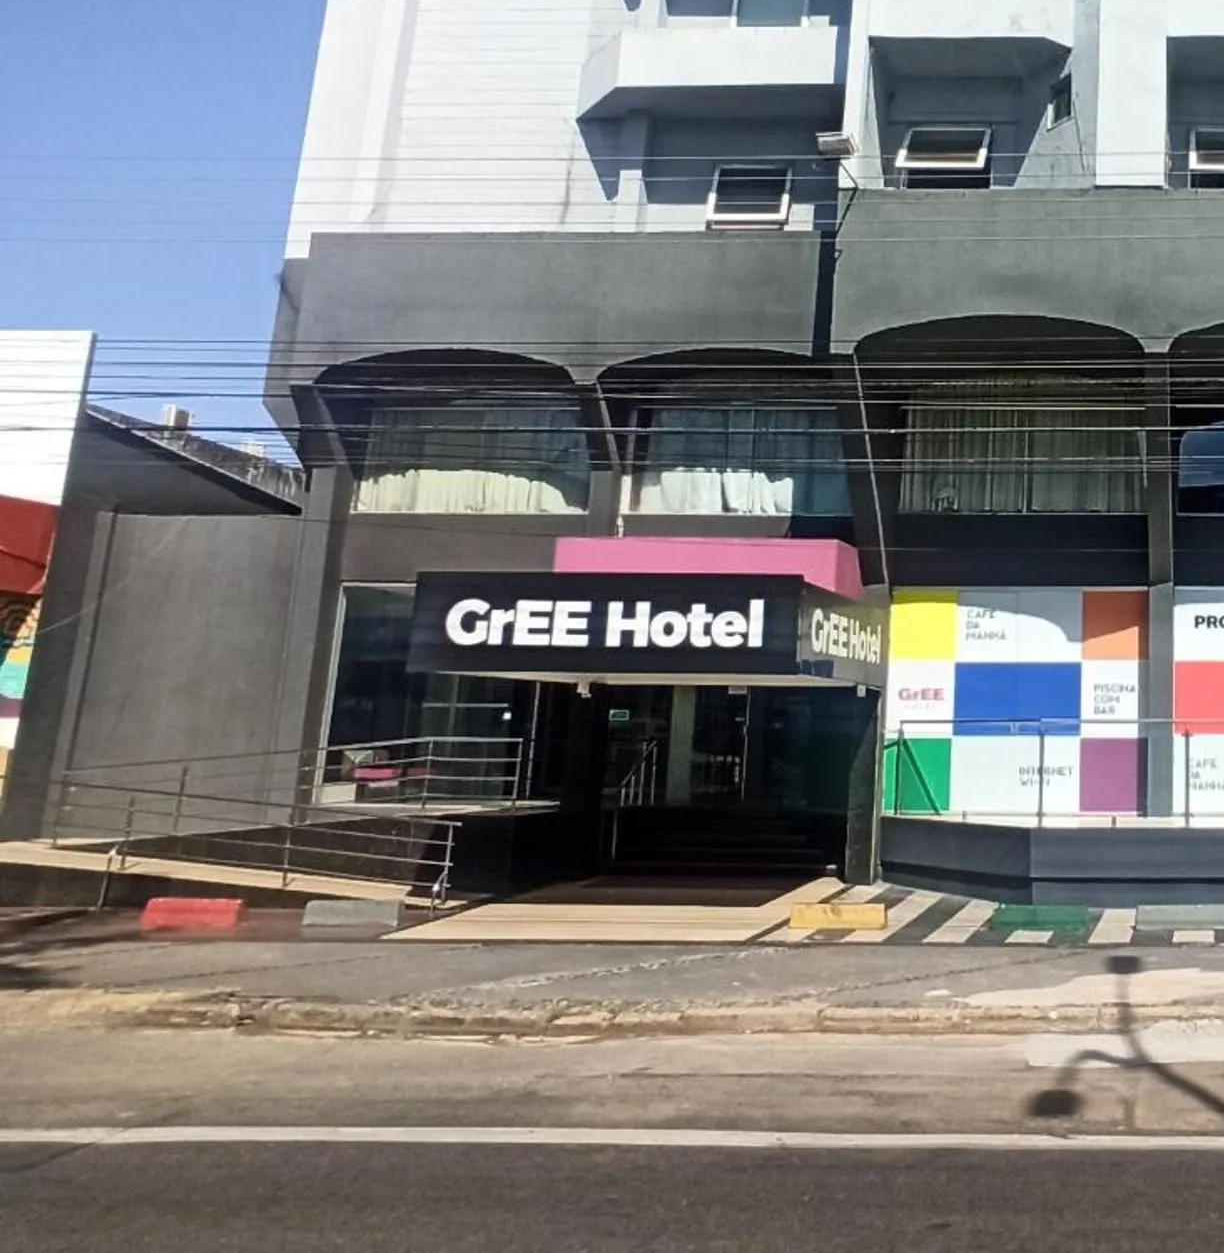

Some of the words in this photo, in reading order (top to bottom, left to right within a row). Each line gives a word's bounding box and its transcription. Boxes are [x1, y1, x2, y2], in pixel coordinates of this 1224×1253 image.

[445, 598, 592, 647] GrEE
[605, 599, 765, 648] Hotel
[811, 608, 848, 658] GrEE
[848, 618, 882, 665] Hotel
[897, 687, 945, 702] GrEE
